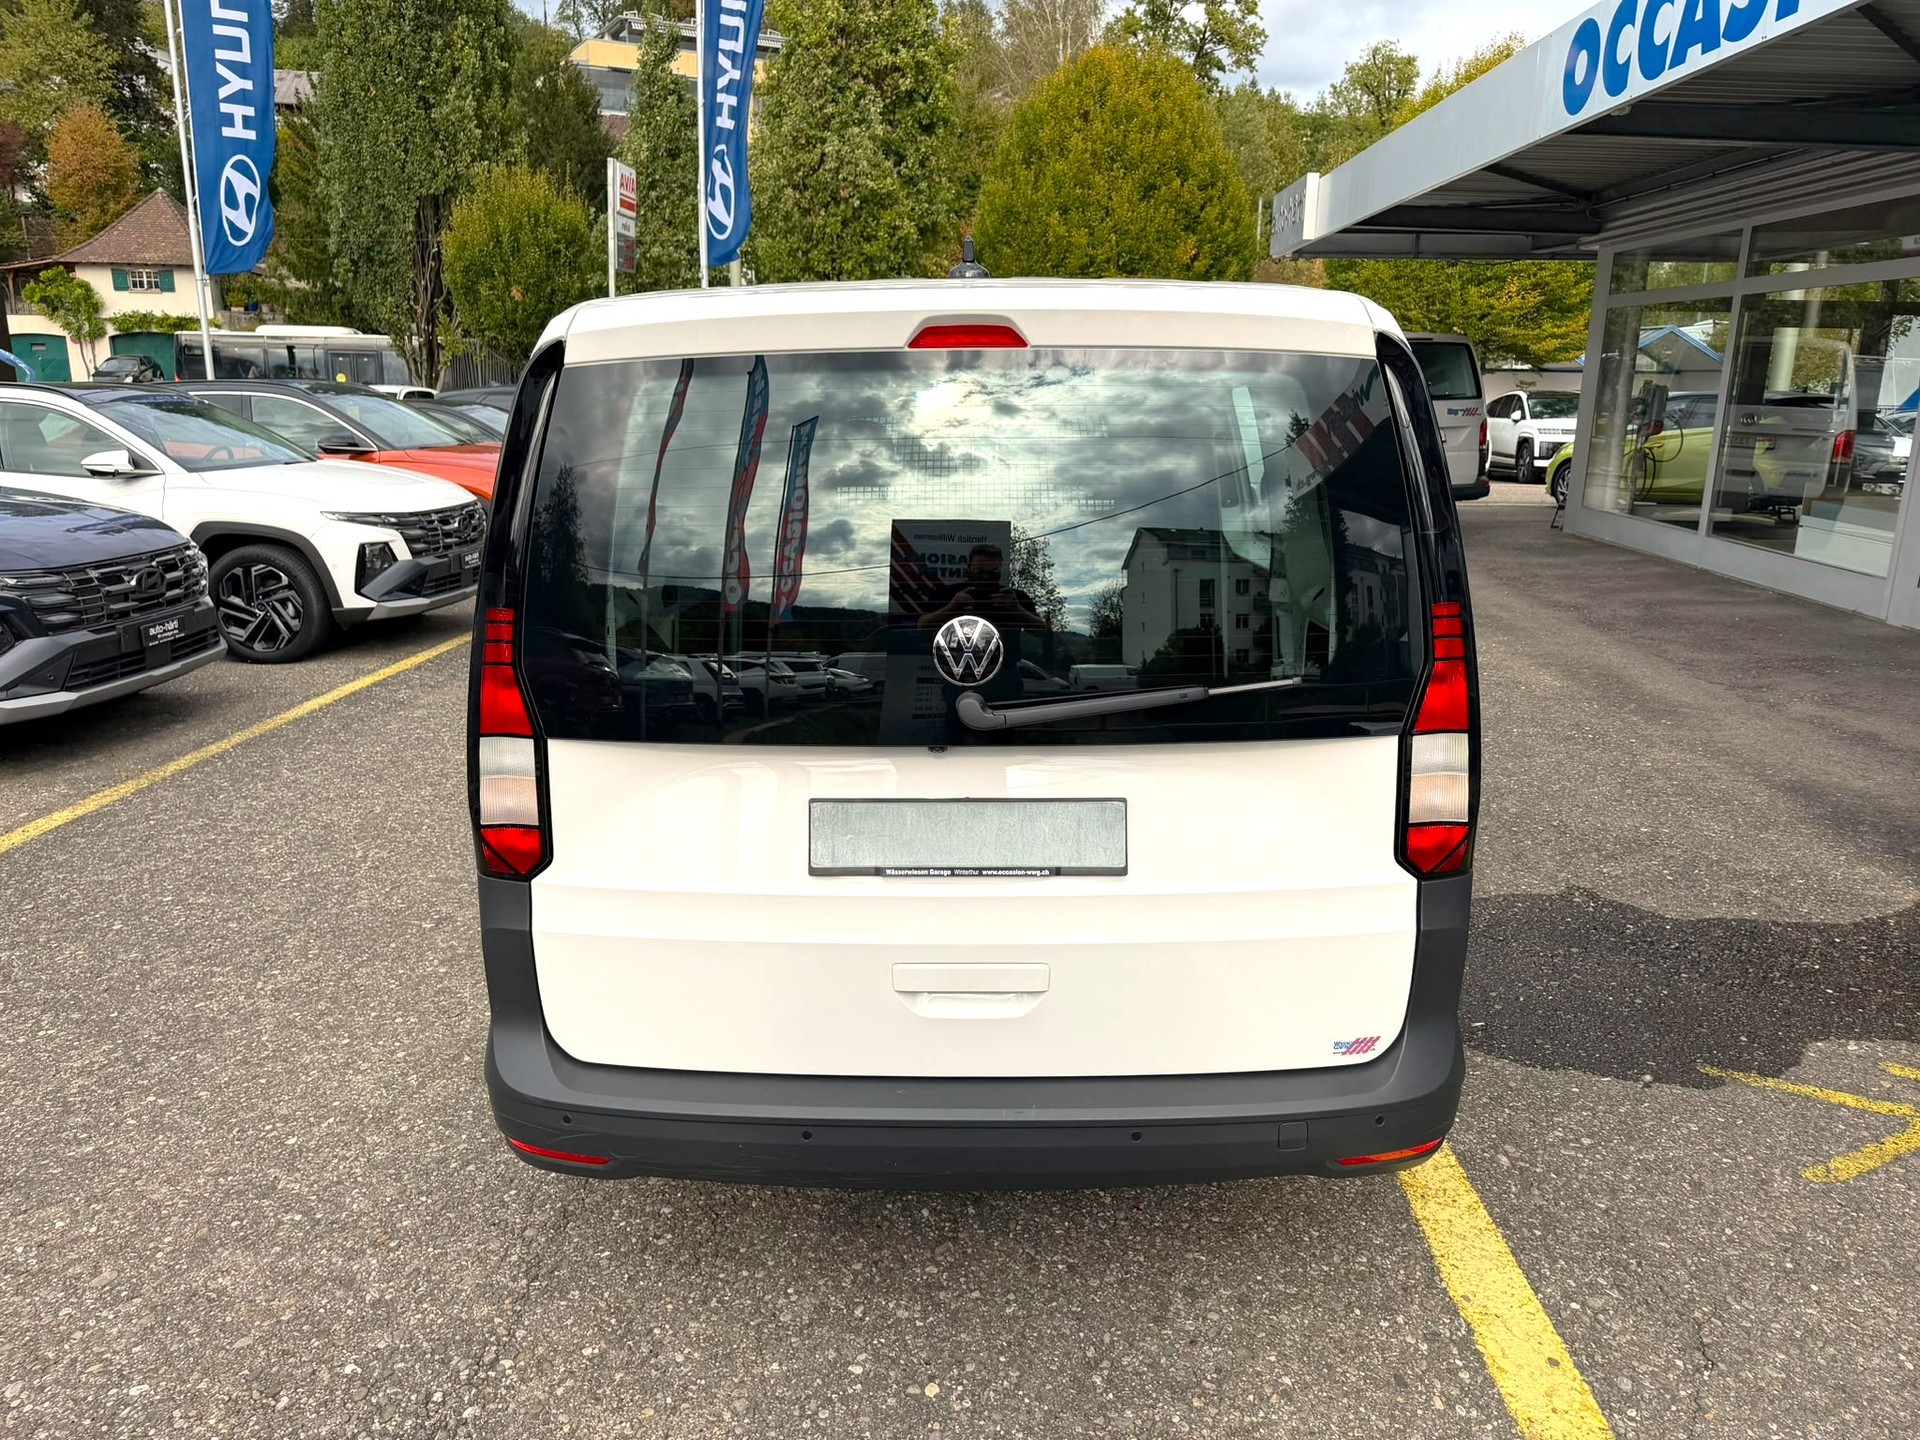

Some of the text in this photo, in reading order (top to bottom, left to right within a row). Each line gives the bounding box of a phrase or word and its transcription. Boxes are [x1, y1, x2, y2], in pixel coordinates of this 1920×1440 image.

[1563, 0, 1800, 116] OCCA
[620, 172, 636, 195] AVIA
[929, 868, 951, 876] Garage
